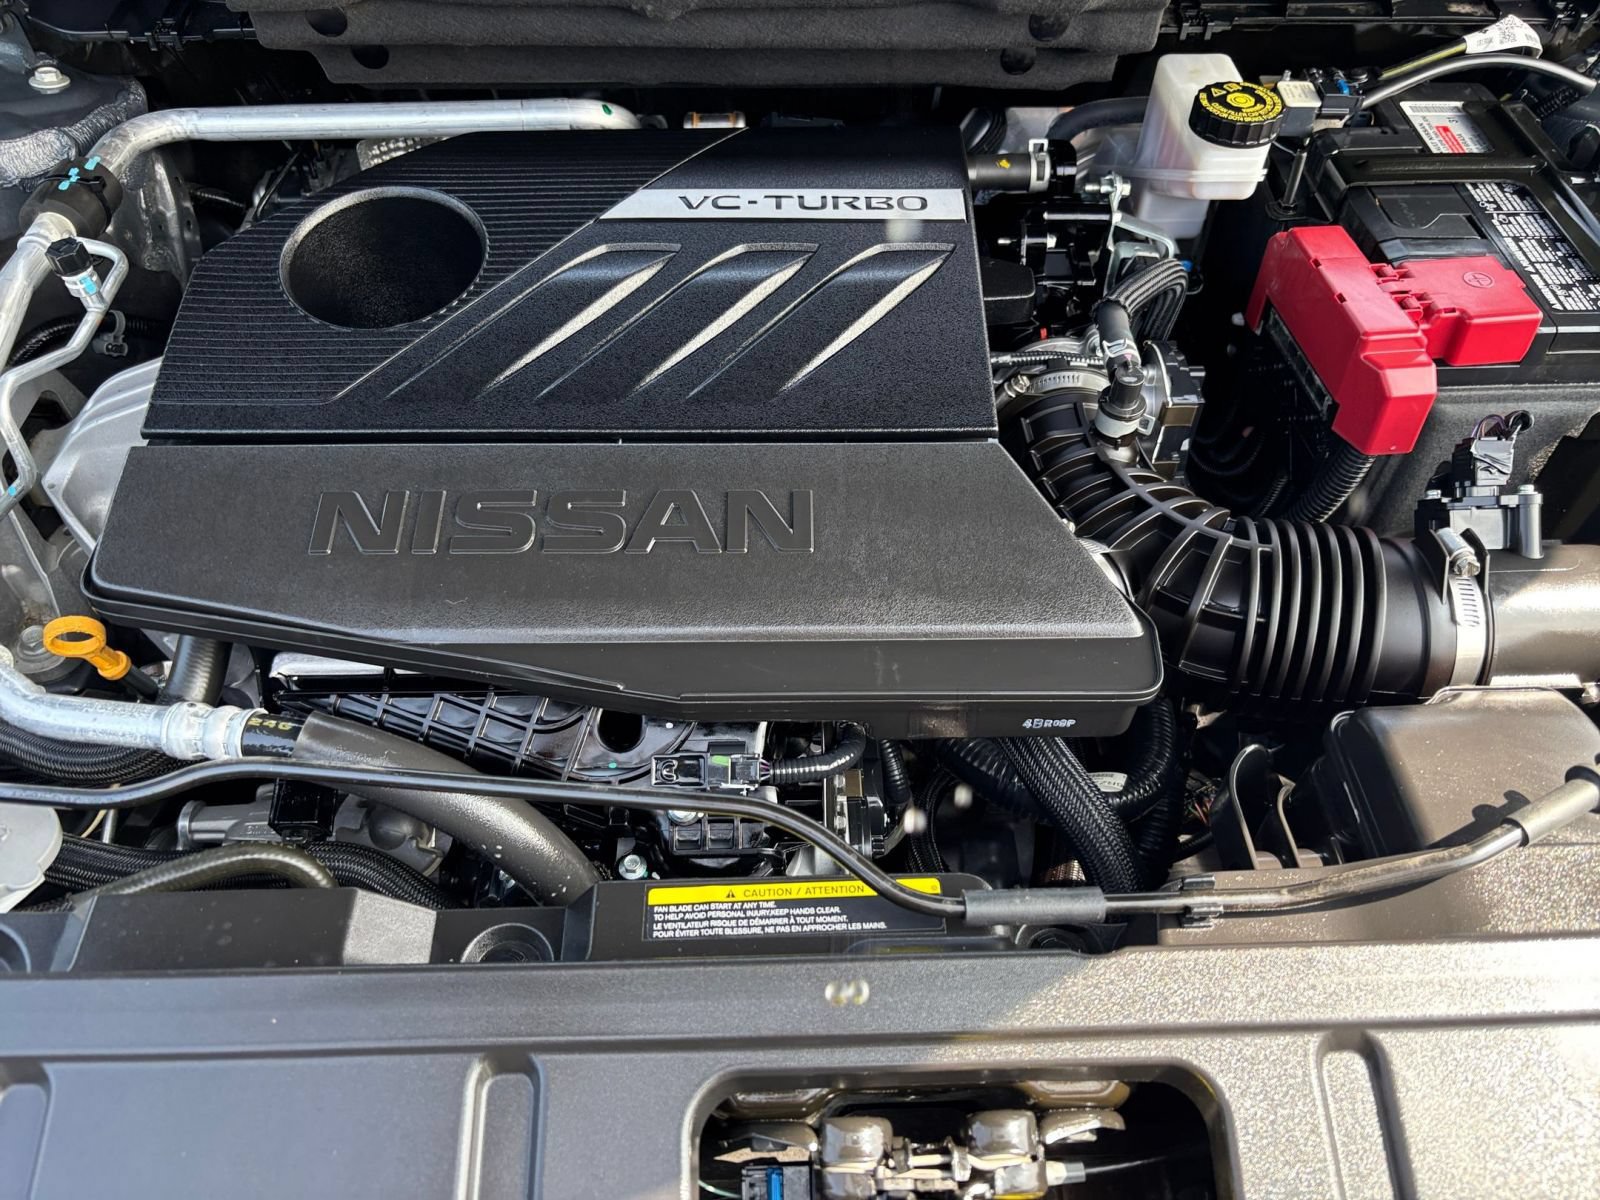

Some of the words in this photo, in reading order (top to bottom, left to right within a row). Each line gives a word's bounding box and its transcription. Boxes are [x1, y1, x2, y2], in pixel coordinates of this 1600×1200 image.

[678, 195, 928, 211] VC-TURBO
[308, 489, 814, 555] NISSAN
[743, 887, 792, 898] CAUTION
[796, 887, 801, 896] /
[804, 885, 864, 895] ATTENTION
[654, 905, 668, 913] FAN
[669, 904, 692, 912] BLADE
[693, 903, 709, 911] CAN
[710, 902, 732, 910] START
[742, 901, 757, 909] ANY
[654, 913, 664, 921] TO
[665, 912, 683, 921] HELP
[684, 911, 706, 920] AVOID
[707, 910, 745, 919] PERSONAL
[790, 907, 815, 915] HANDS
[816, 906, 841, 914] CLEAR.
[653, 930, 674, 938] POUR
[675, 927, 700, 937] ÉVITER
[700, 927, 723, 936] TOUTE
[724, 926, 763, 935] BLESSURE,
[765, 925, 775, 933] NE
[791, 924, 802, 932] EN
[802, 923, 847, 931] APPROCHER
[848, 922, 862, 930] LES
[862, 921, 887, 929] MAINS.
[663, 921, 709, 930] VENTILATEUR
[710, 919, 737, 928] RISQUE
[749, 916, 789, 926] DÉMARRER
[789, 916, 796, 924] À
[795, 915, 815, 924] TOUT
[815, 915, 848, 923] MOMENT.
